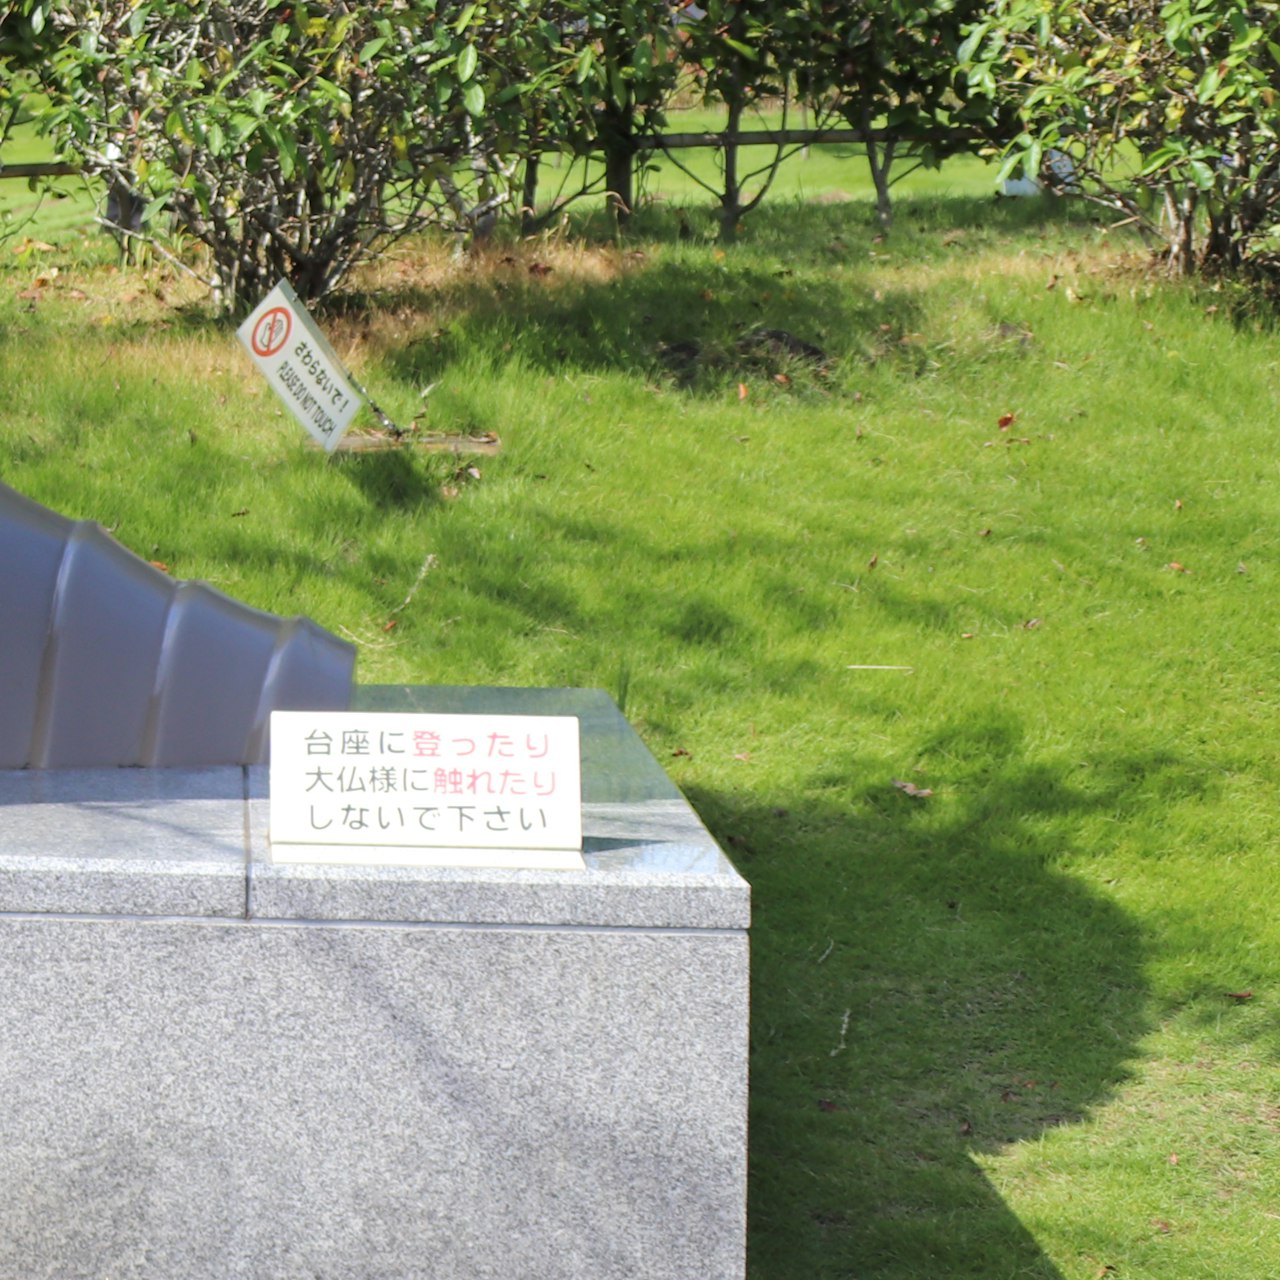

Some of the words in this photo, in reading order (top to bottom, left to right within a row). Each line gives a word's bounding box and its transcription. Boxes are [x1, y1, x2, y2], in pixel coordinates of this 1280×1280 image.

[276, 361, 301, 391] PLEASE
[293, 382, 308, 401] DO
[301, 391, 317, 414] NOT
[311, 405, 338, 438] TOUCH
[303, 728, 549, 759] 台座に登ったり
[304, 765, 557, 796] 大仏様に触れたり
[309, 803, 548, 833] しないで下さい
